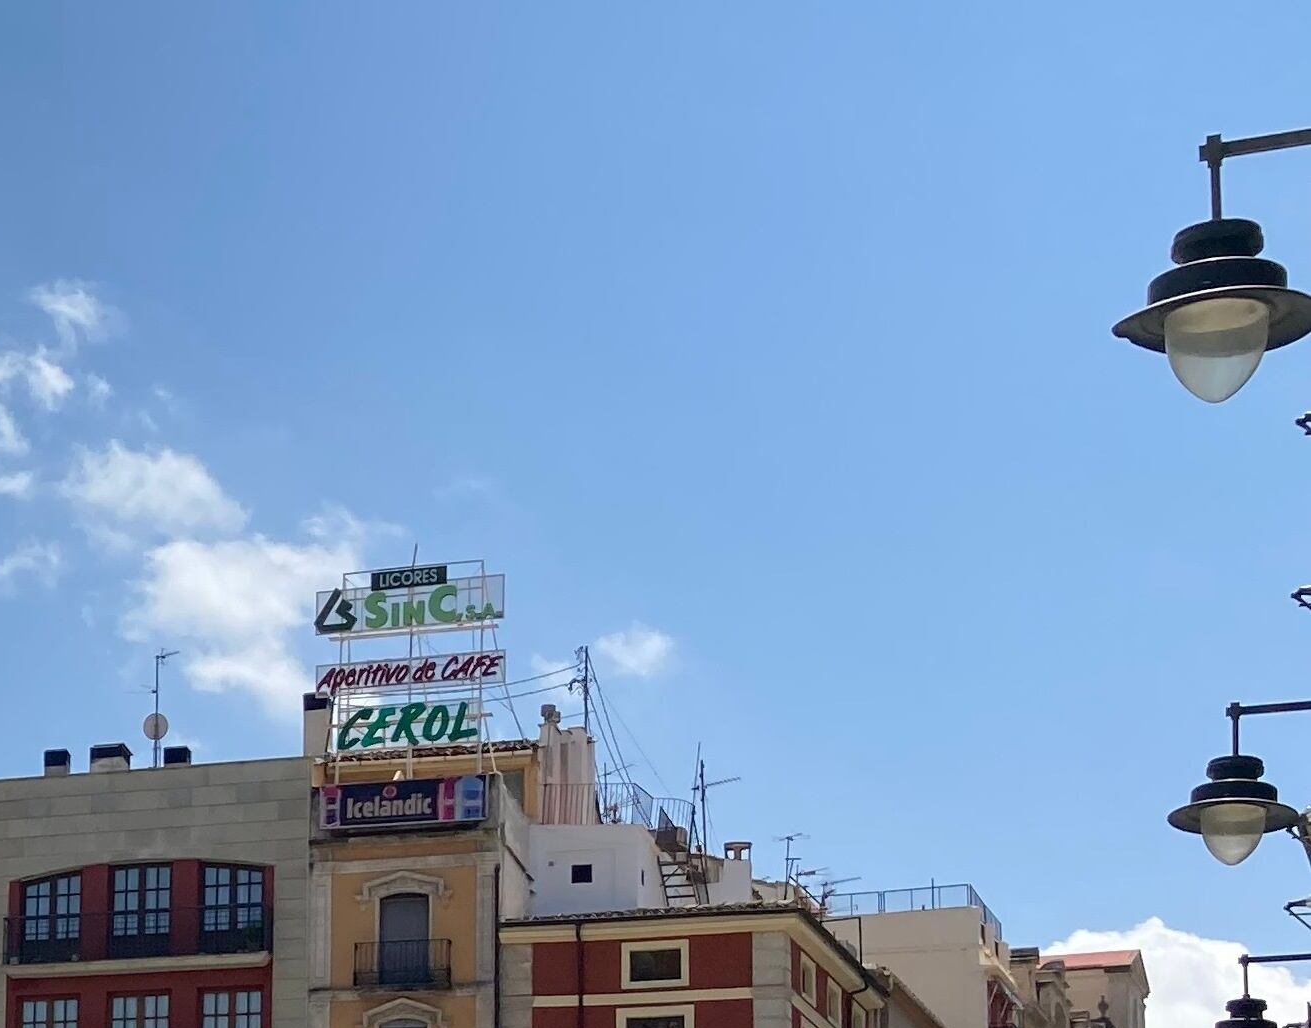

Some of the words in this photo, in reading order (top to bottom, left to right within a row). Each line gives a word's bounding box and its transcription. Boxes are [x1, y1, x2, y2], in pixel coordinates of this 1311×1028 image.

[380, 569, 438, 587] LICORES
[317, 662, 410, 698] Aperitivo
[412, 659, 436, 683] de
[337, 701, 478, 750] CEROL
[346, 792, 433, 819] Icelandic
